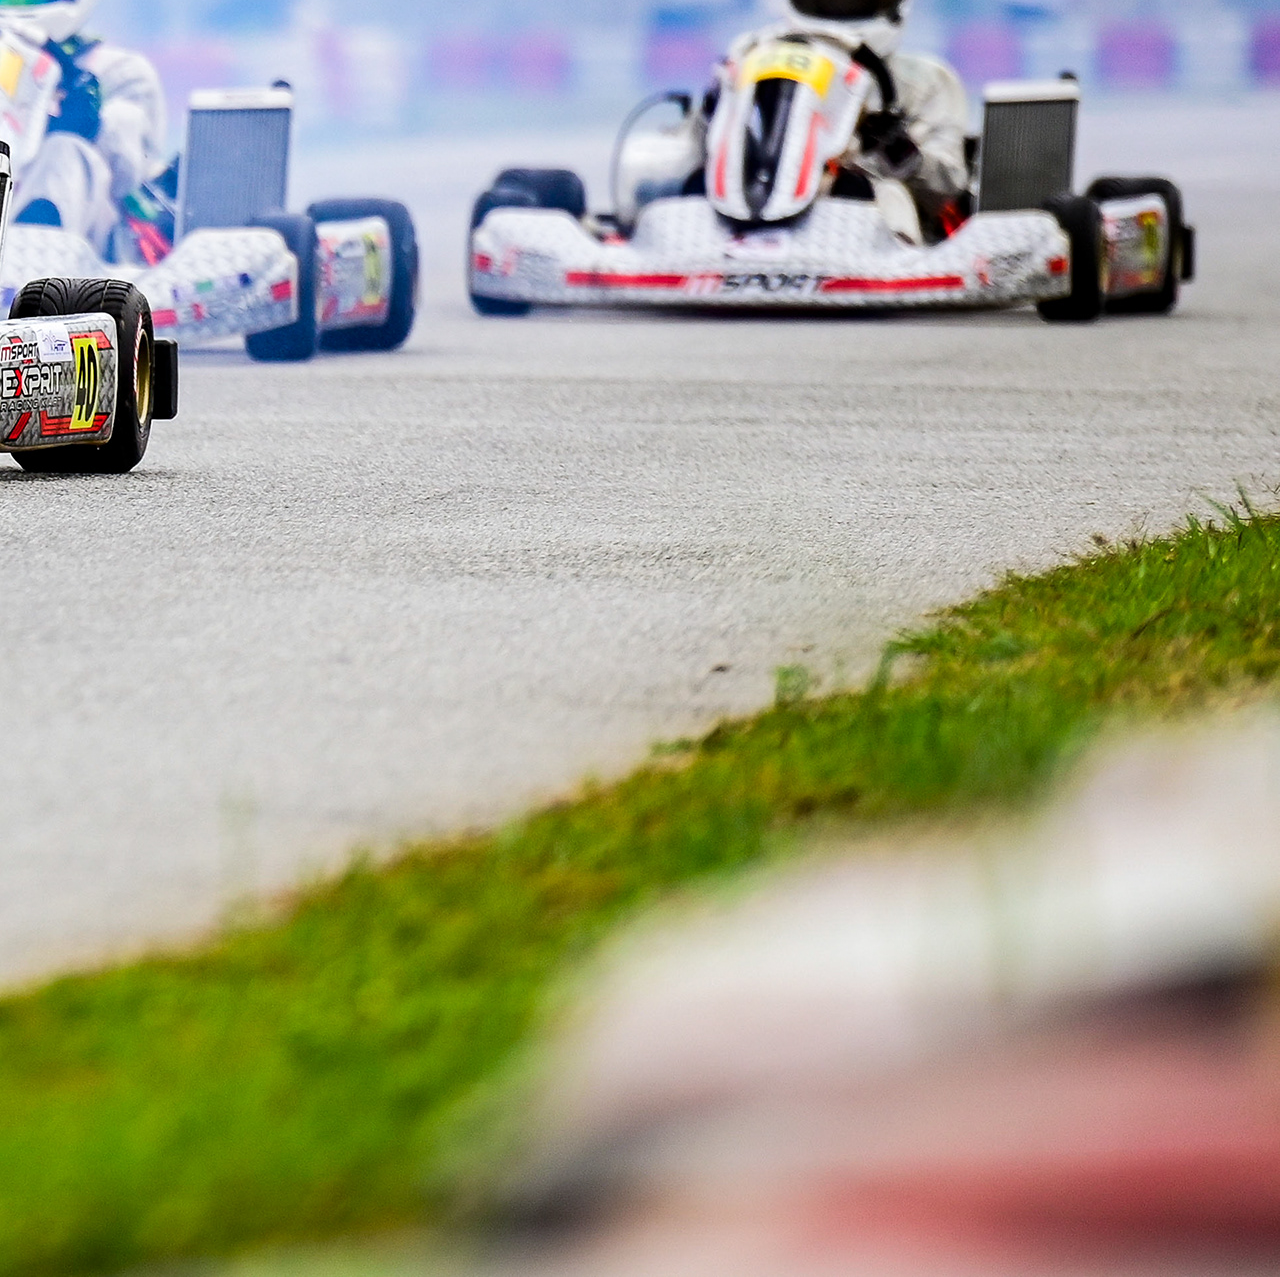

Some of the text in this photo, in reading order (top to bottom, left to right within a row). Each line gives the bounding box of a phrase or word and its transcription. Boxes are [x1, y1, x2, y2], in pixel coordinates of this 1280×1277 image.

[0, 363, 63, 400] EXPRIT
[75, 343, 98, 423] 40
[0, 400, 39, 413] RACING
